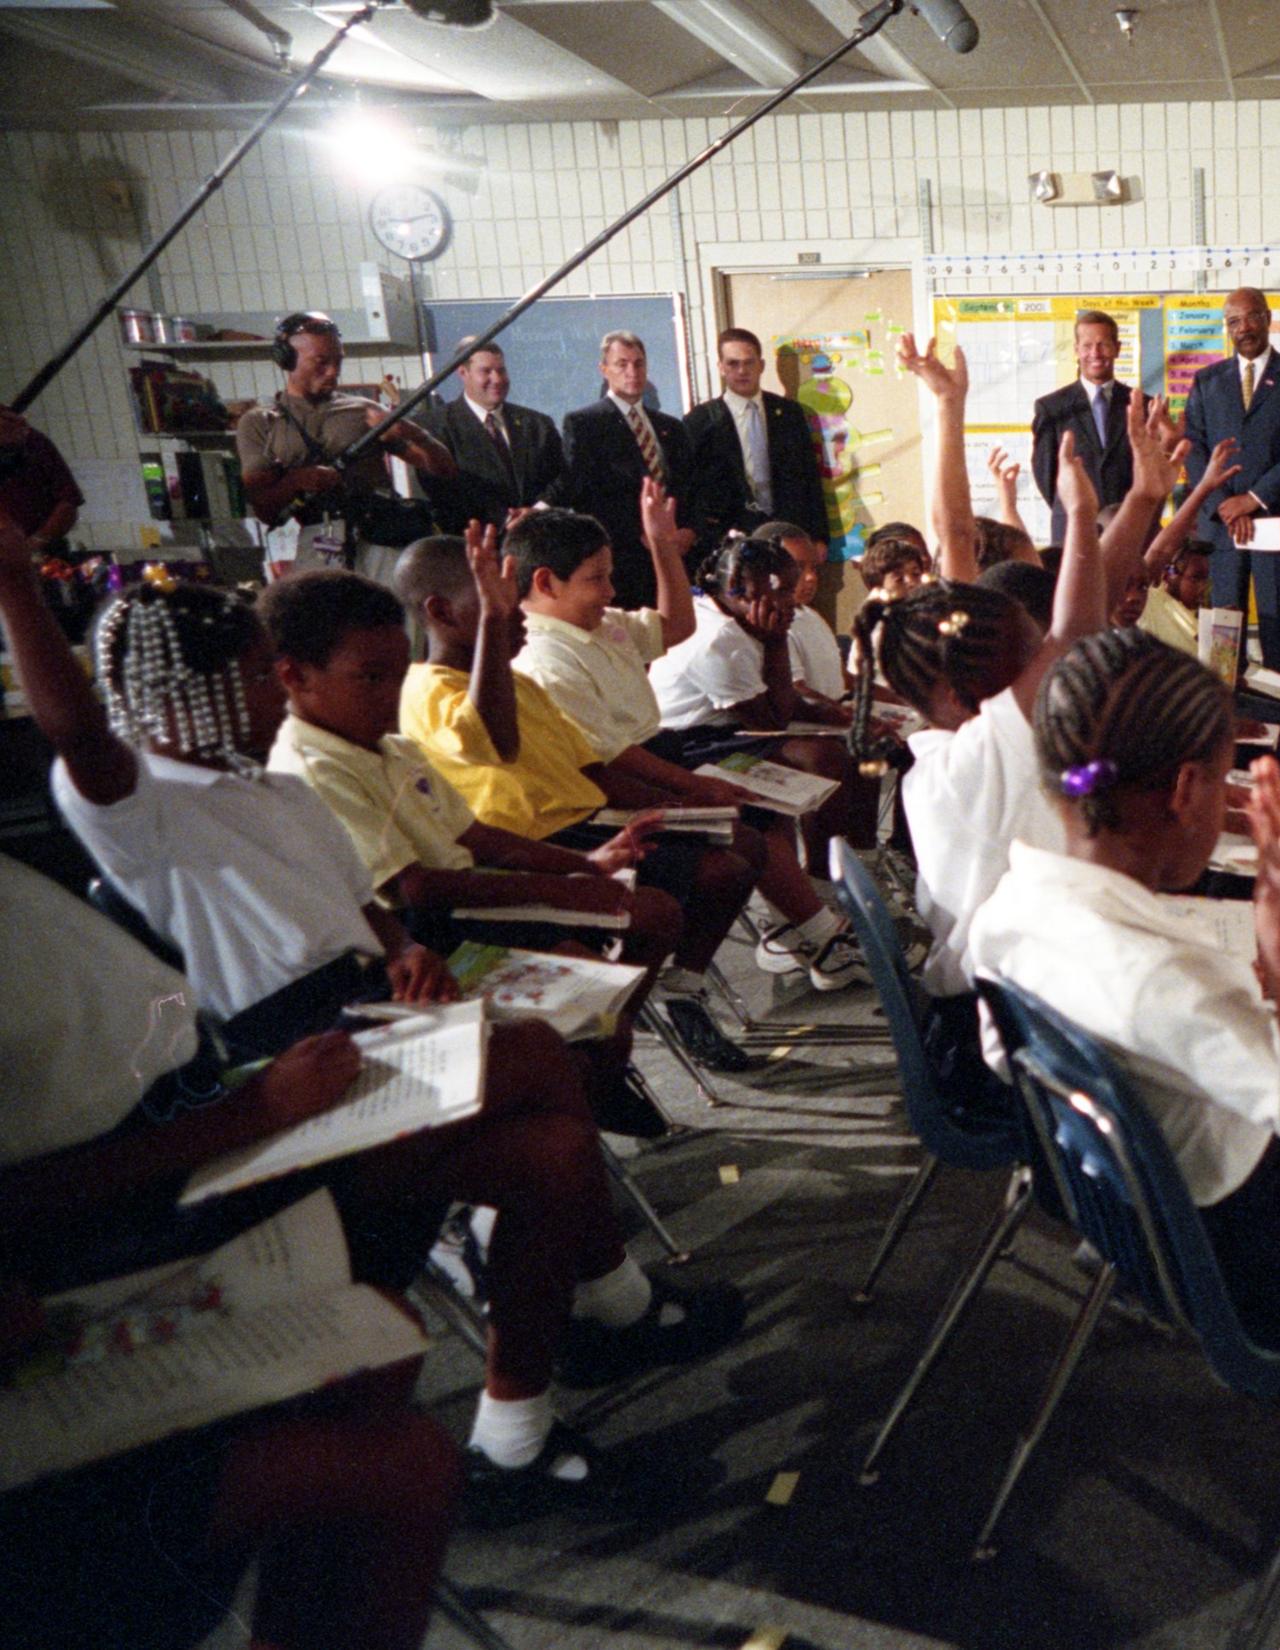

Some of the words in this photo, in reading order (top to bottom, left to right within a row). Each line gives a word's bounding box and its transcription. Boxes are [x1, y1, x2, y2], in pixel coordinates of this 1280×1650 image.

[1180, 300, 1210, 308] Months
[1179, 310, 1211, 320] January
[1179, 325, 1215, 335] February
[1180, 341, 1204, 350] March
